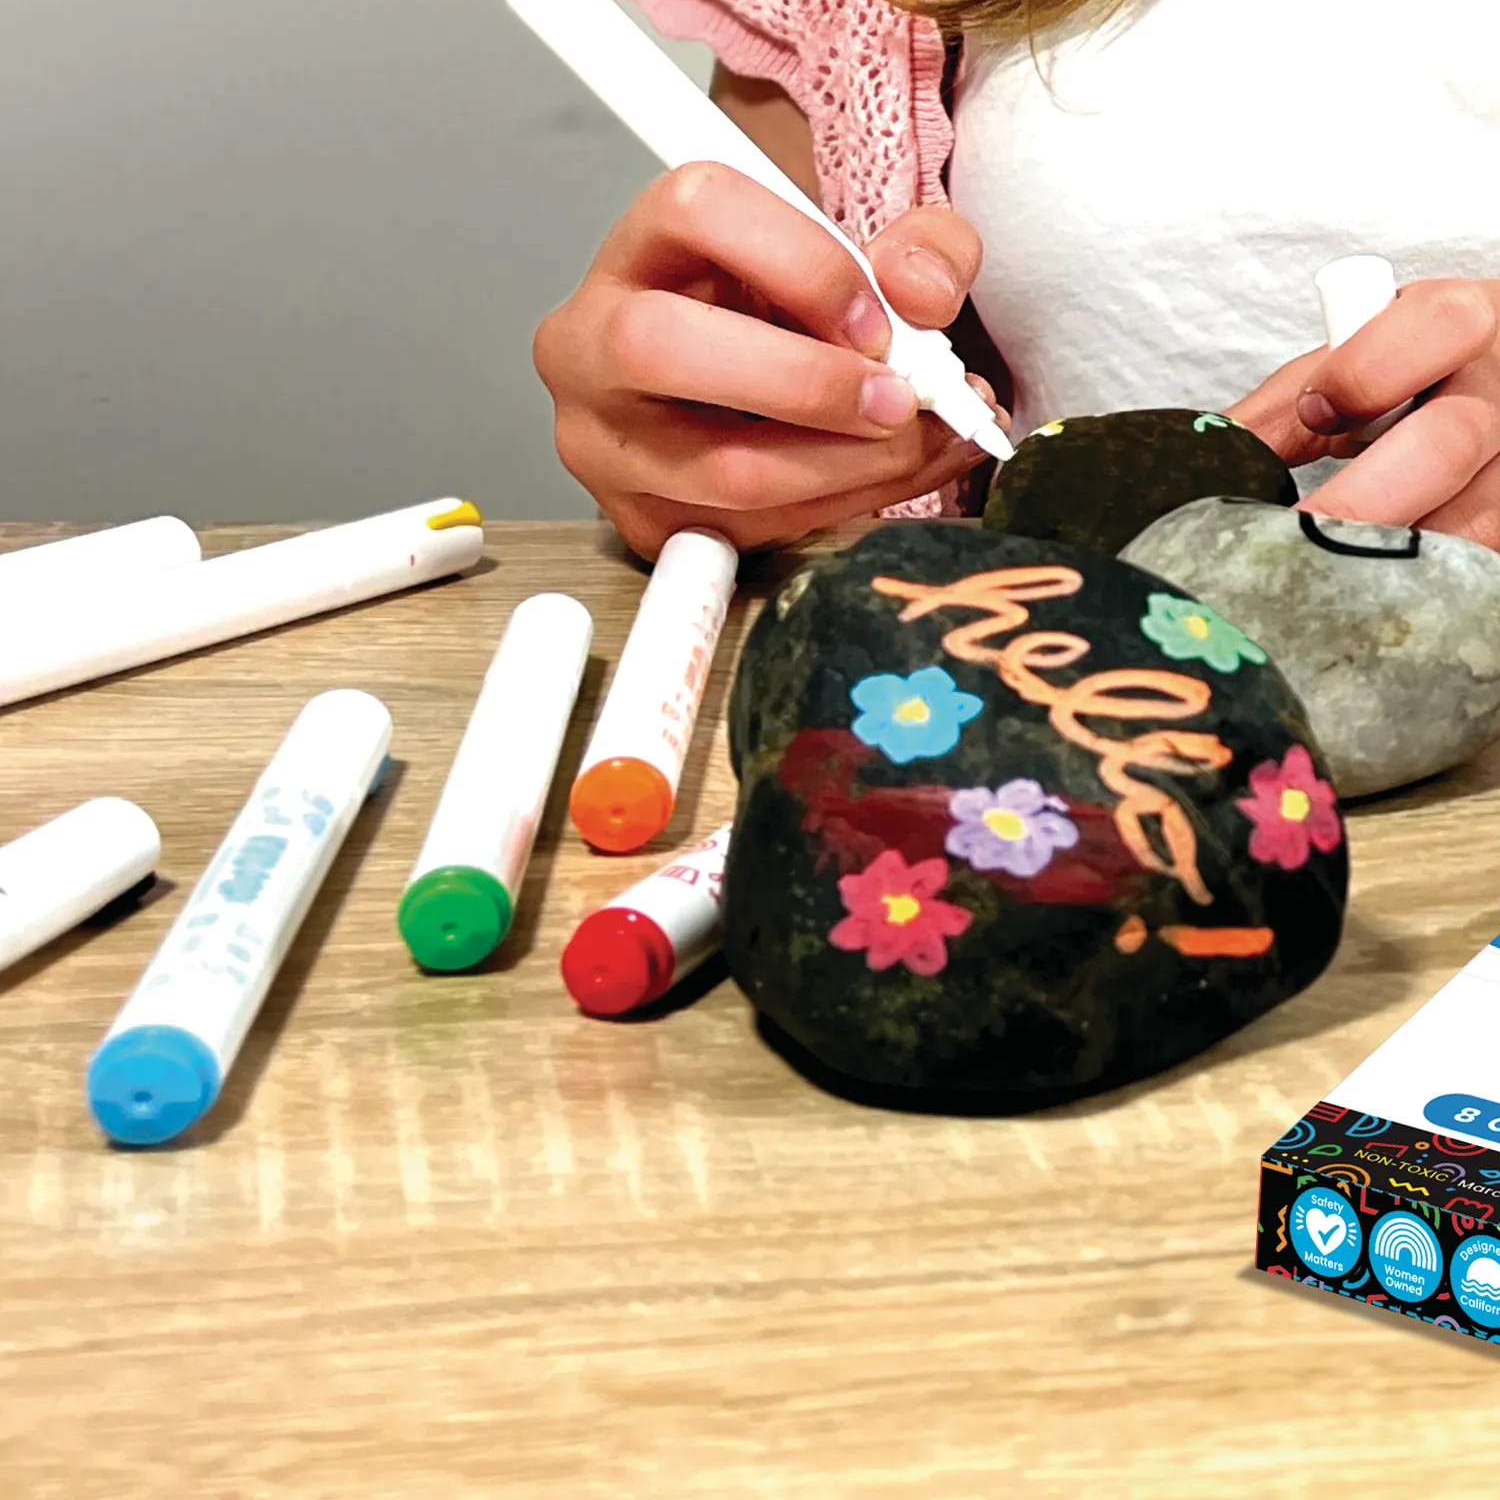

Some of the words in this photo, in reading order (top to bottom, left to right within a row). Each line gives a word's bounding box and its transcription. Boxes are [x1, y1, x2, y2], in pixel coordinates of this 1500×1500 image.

[1453, 1107, 1482, 1124] 8
[1353, 1149, 1450, 1183] NON-TOXIC
[1310, 1193, 1345, 1214] Safety
[1304, 1251, 1344, 1272] Matters
[1383, 1263, 1426, 1285] Women
[1385, 1276, 1423, 1297] Owned
